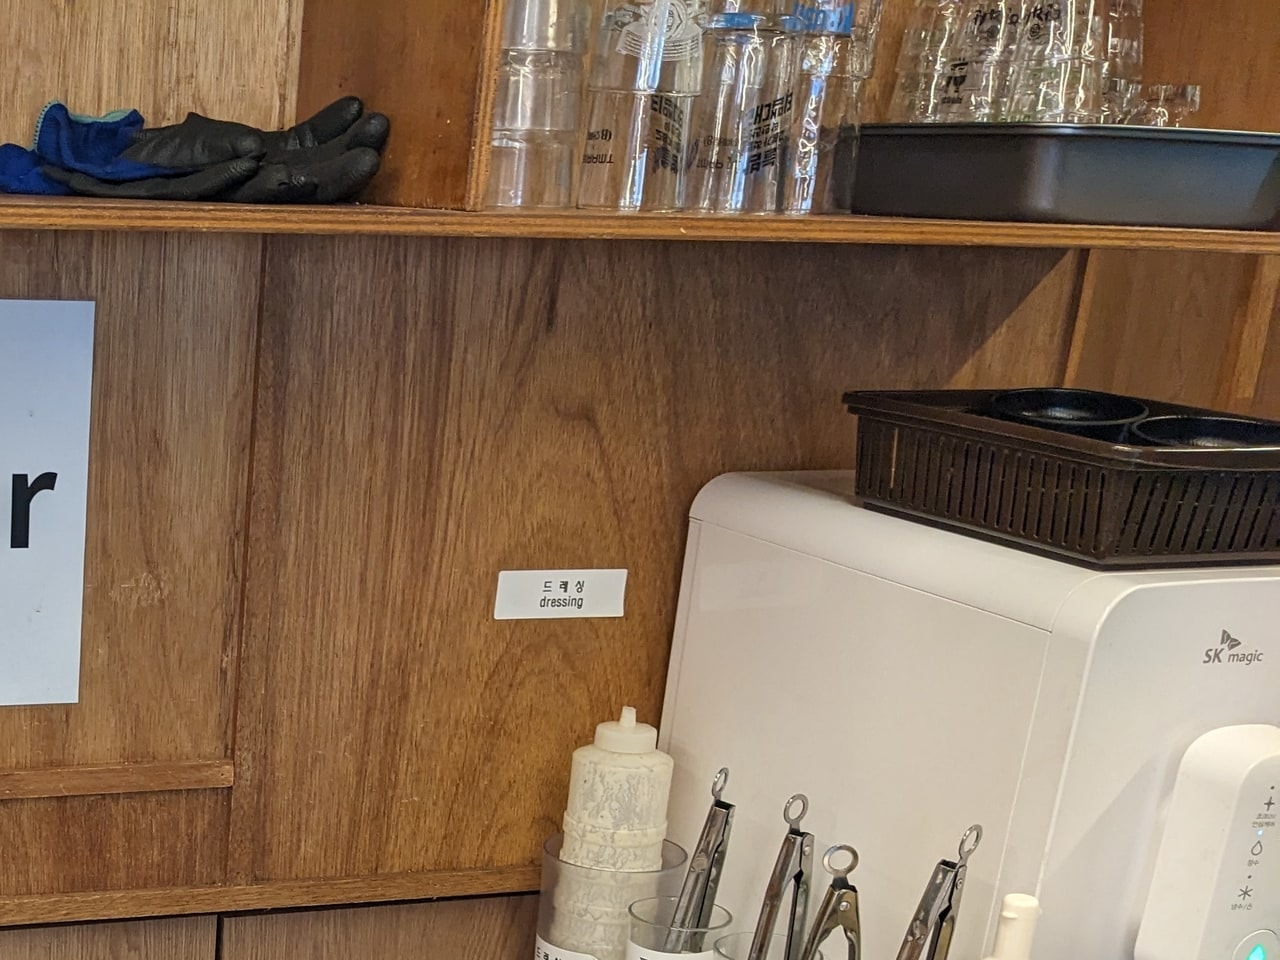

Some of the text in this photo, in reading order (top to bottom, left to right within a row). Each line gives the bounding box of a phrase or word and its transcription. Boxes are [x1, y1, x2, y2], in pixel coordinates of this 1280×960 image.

[539, 595, 584, 610] dressing
[1202, 647, 1264, 665] SK magic
